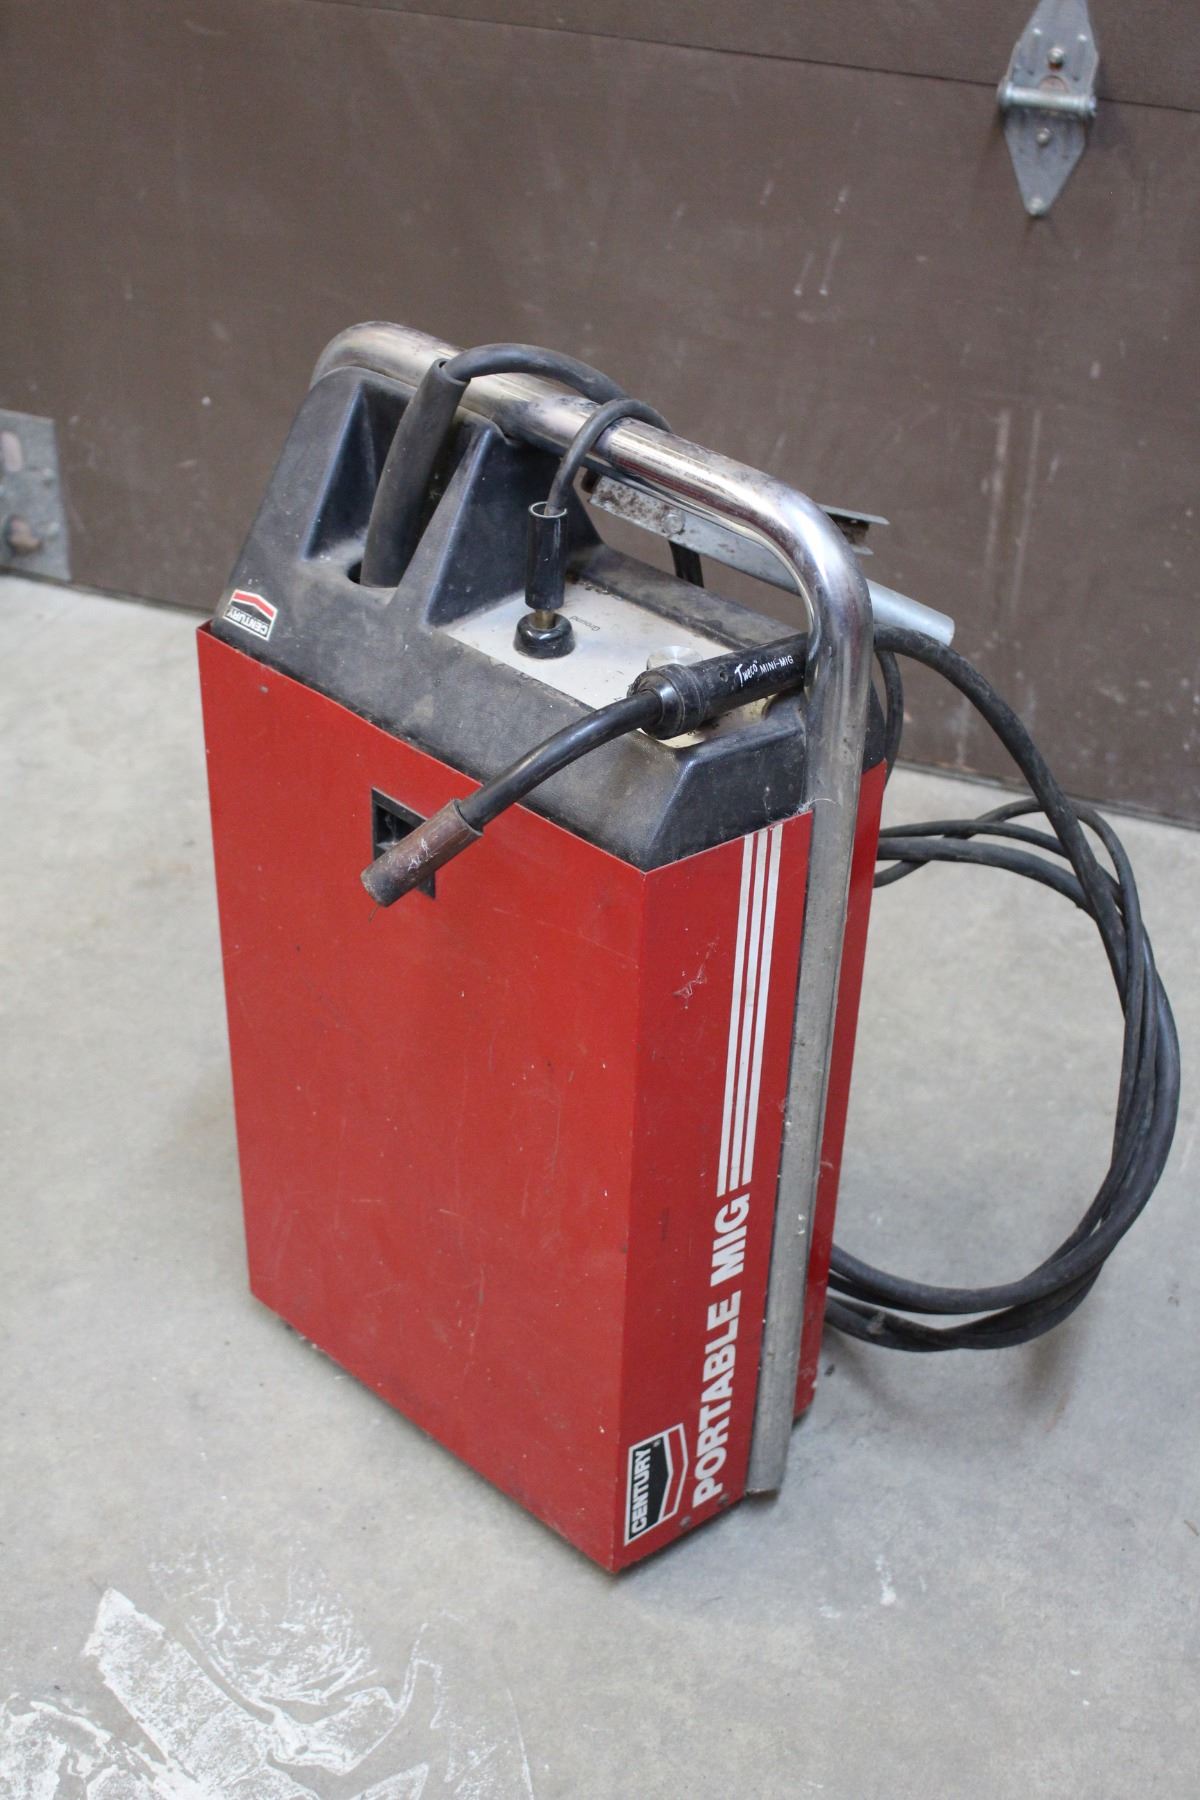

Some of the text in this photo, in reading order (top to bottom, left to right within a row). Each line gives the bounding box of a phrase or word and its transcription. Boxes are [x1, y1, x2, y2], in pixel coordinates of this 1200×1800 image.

[227, 608, 269, 635] CENTURY
[570, 615, 601, 632] Ground
[759, 655, 794, 675] MINI-MIG
[692, 1193, 751, 1508] PORTABLE MIG
[631, 1448, 652, 1534] CENTURY
